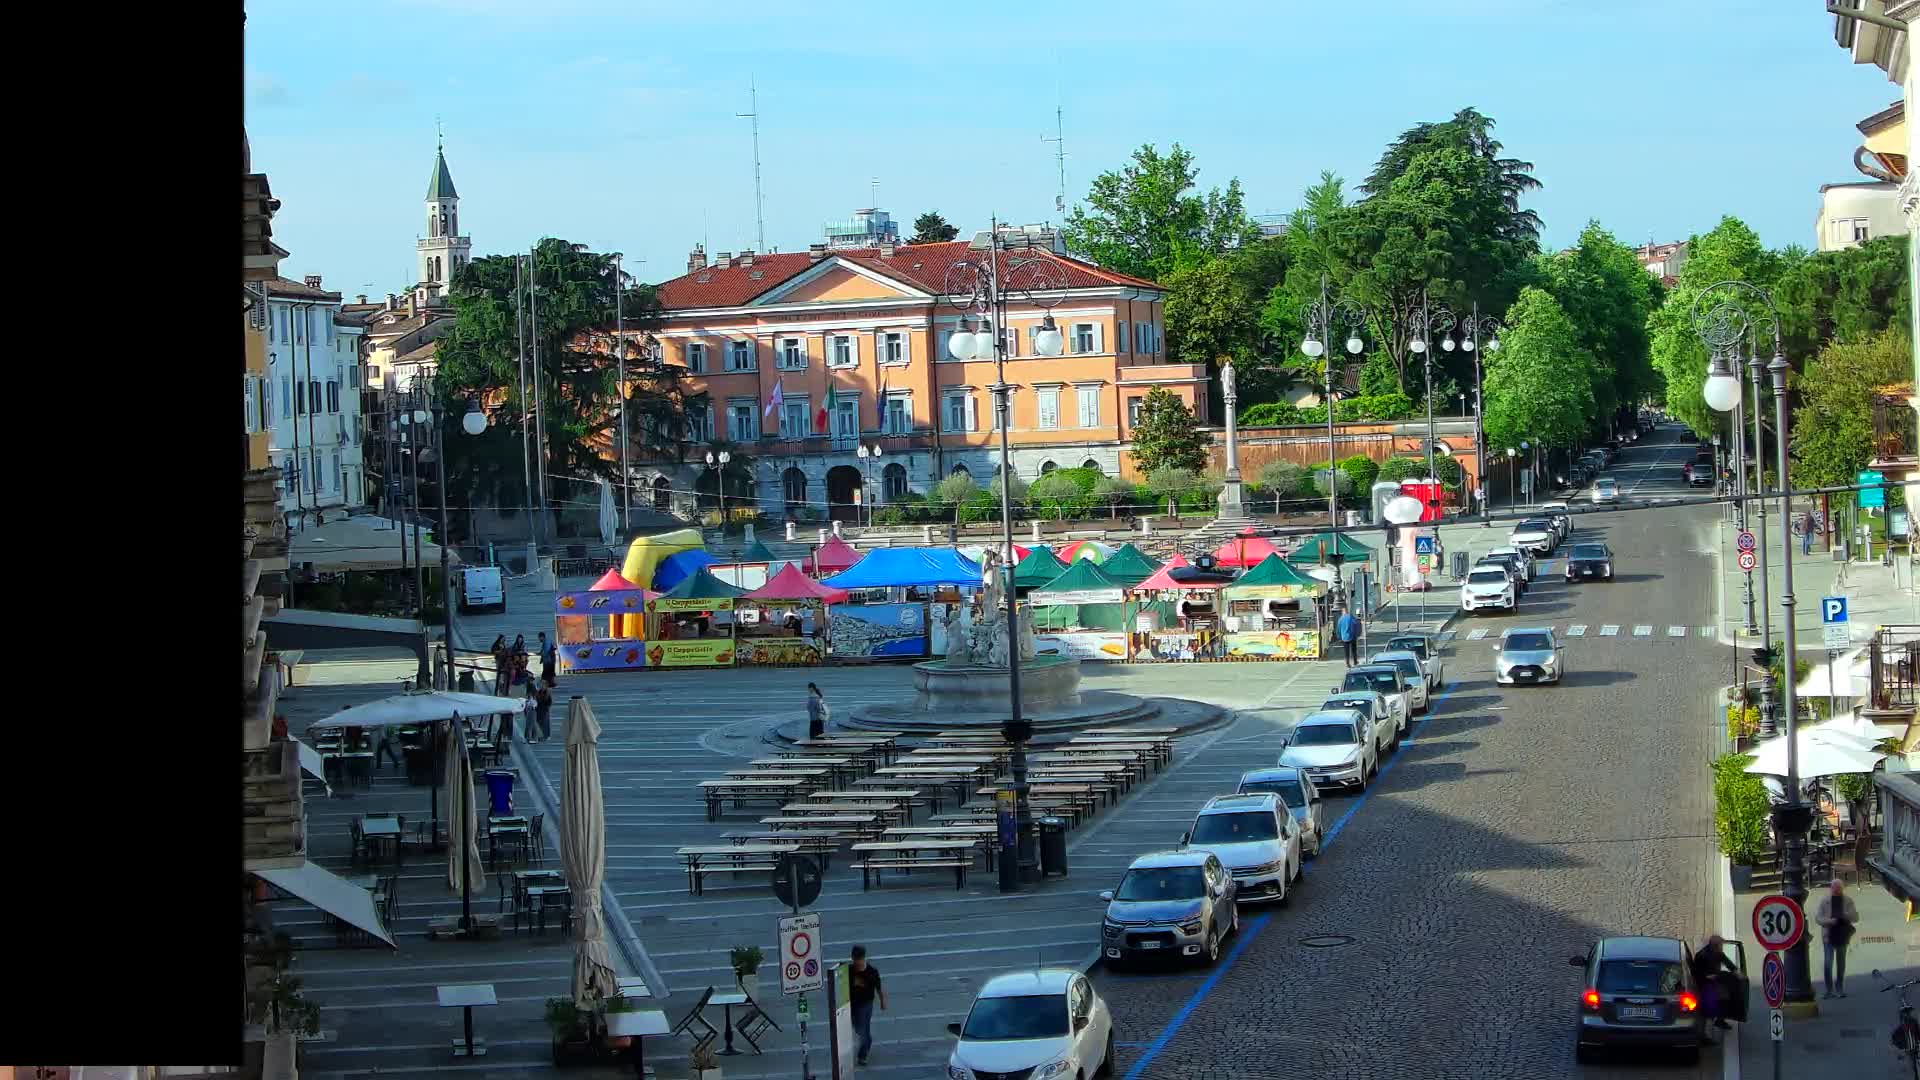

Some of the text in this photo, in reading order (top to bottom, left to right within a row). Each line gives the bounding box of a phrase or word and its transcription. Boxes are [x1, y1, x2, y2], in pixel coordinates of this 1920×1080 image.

[1742, 557, 1753, 566] 20
[1827, 600, 1842, 620] P
[1762, 910, 1792, 936] 30
[789, 967, 798, 977] 20
